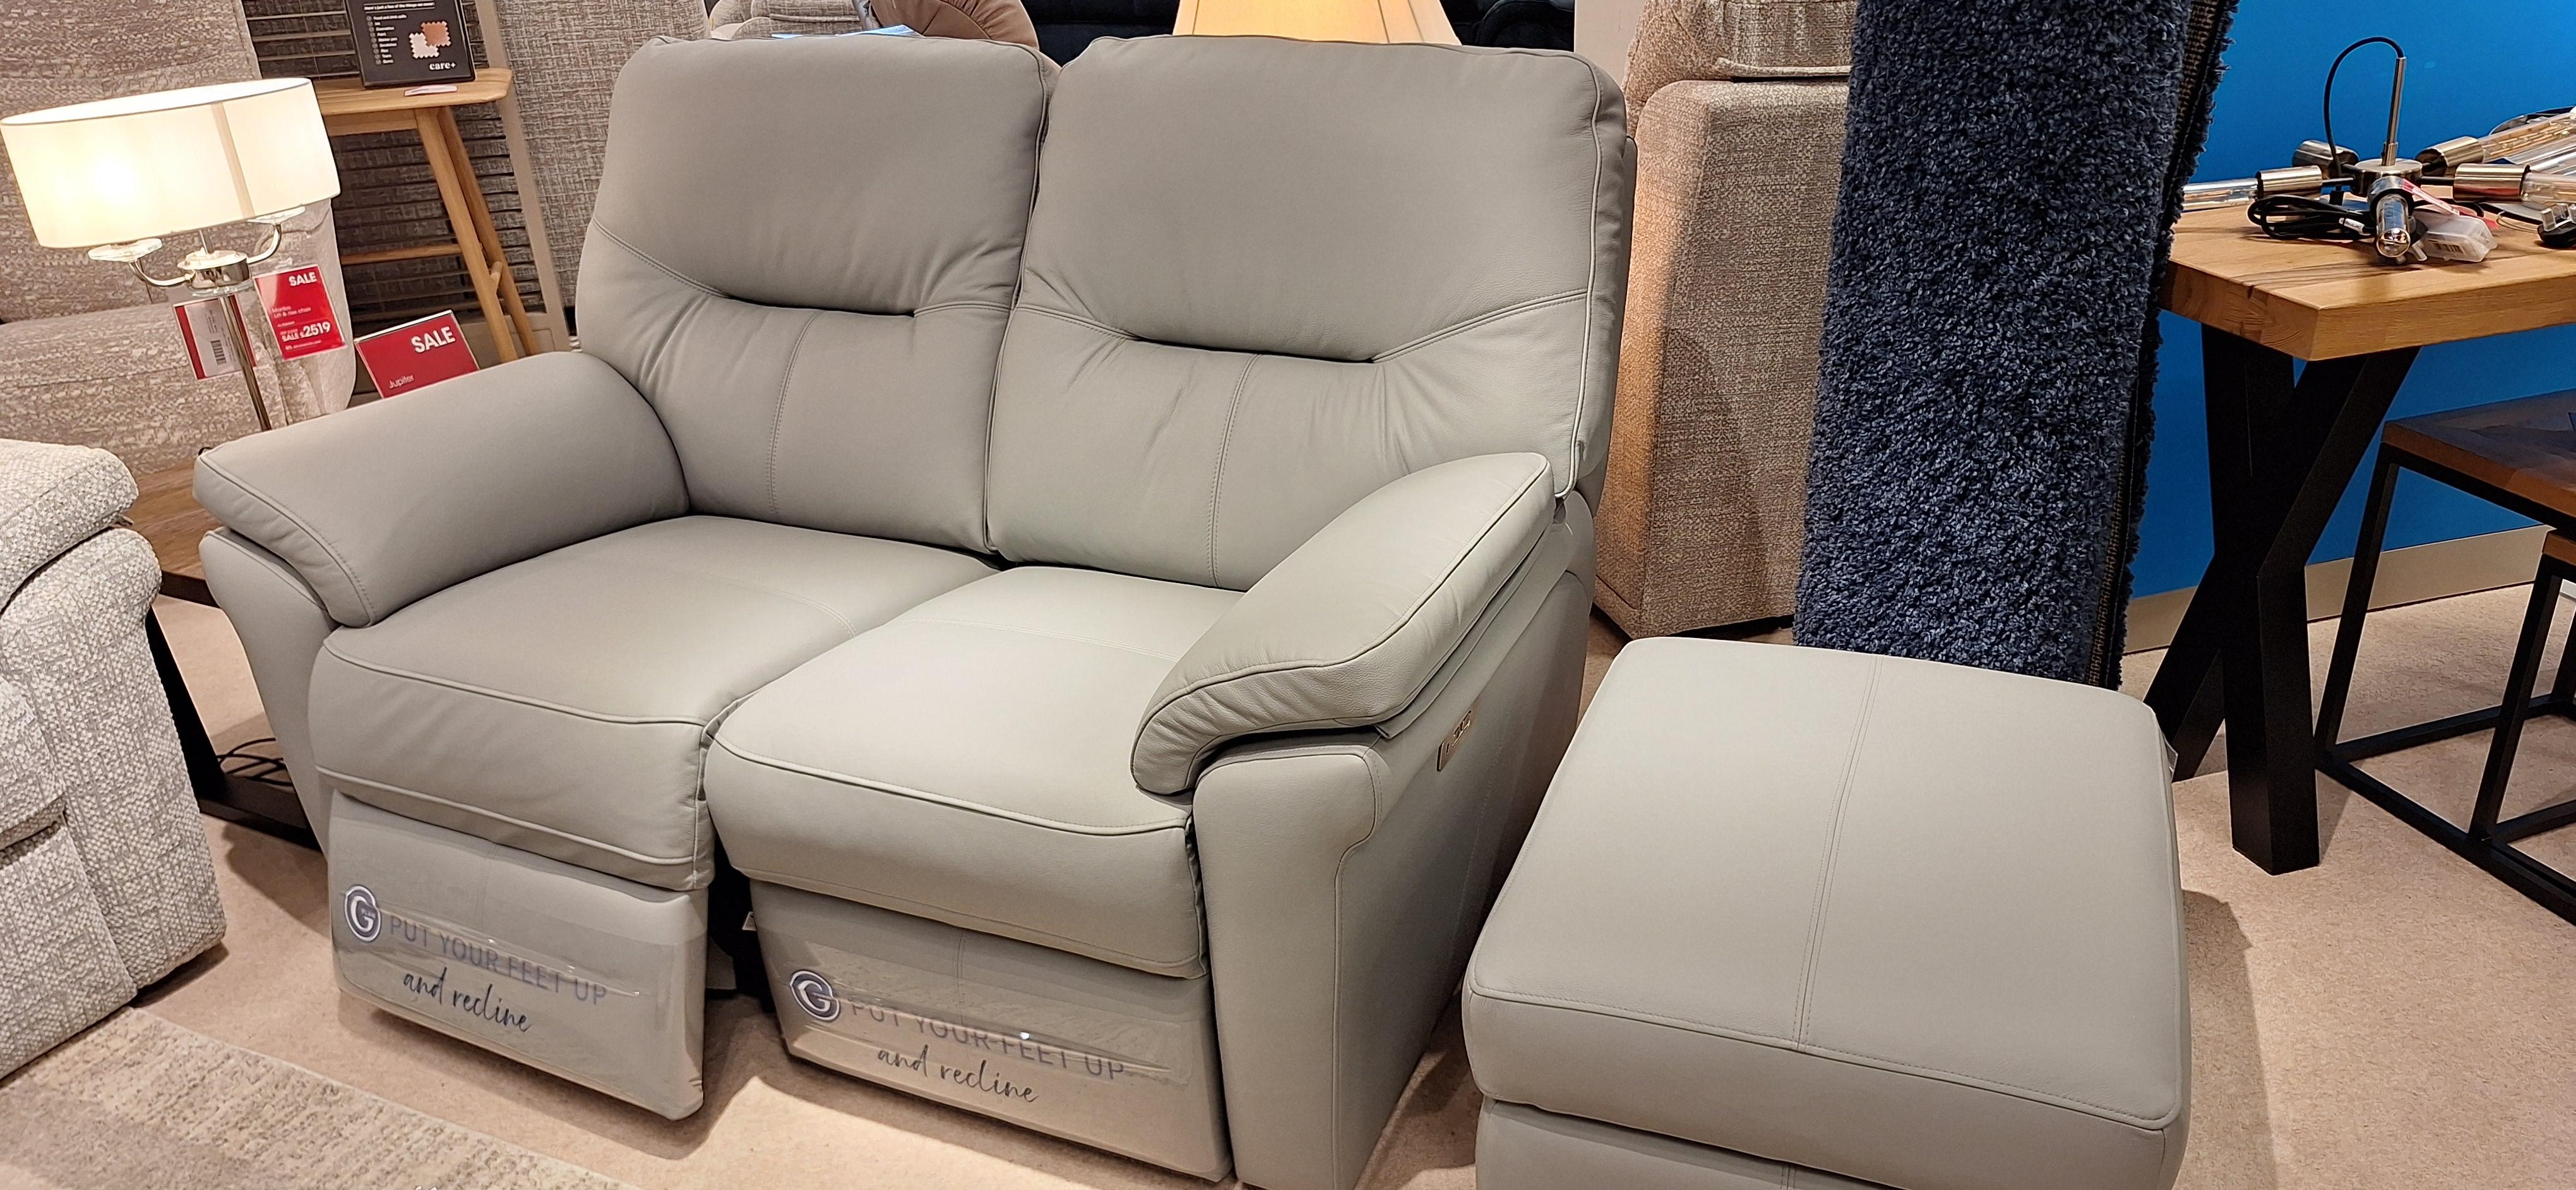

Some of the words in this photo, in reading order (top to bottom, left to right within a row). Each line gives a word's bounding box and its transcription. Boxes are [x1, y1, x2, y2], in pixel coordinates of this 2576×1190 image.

[429, 62, 456, 70] care+
[289, 272, 317, 286] SALE
[282, 332, 299, 342] SALE
[411, 326, 456, 353] SALE
[389, 375, 414, 388] Jupiter
[391, 916, 430, 947] PUT
[439, 931, 498, 971] YOUR
[509, 956, 561, 993] FEET
[575, 977, 607, 1004] UP
[403, 967, 448, 1005] and
[453, 983, 532, 1033] recline
[878, 1043, 929, 1078] and
[941, 1059, 1040, 1103] recline
